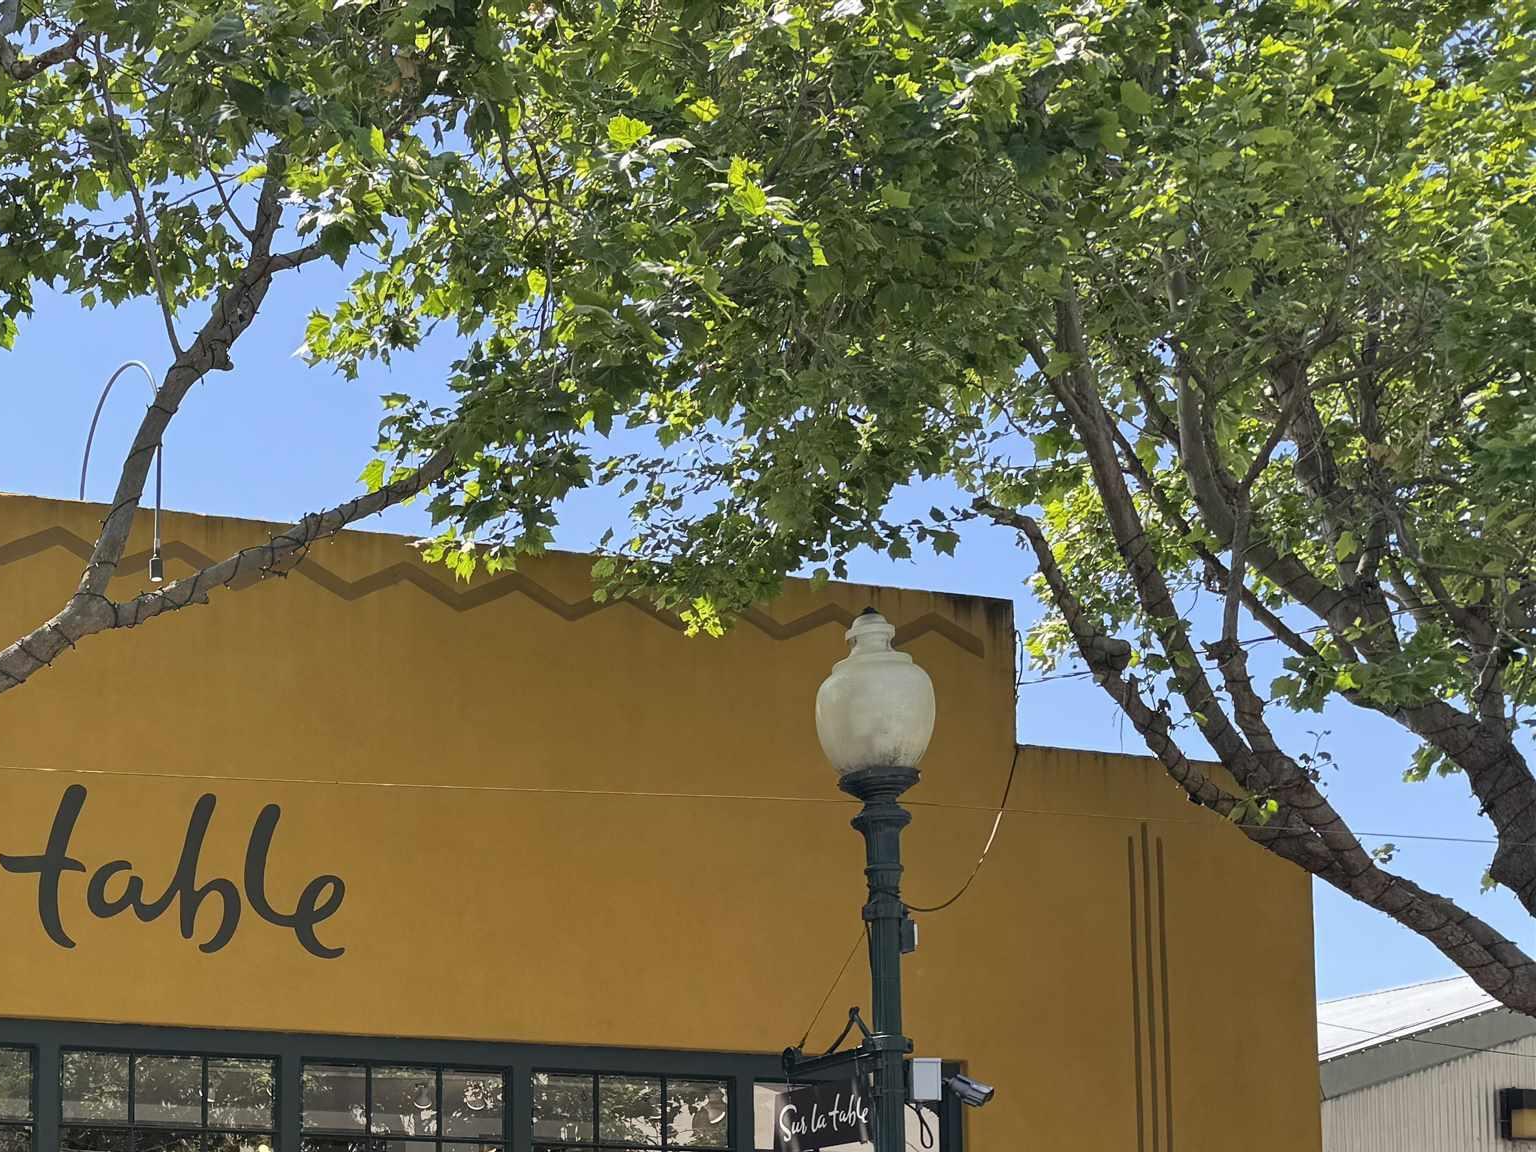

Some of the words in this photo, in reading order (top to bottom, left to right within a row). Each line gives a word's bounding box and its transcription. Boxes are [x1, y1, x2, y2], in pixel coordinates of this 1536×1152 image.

[779, 1104, 808, 1142] Sur
[811, 1103, 828, 1133] la
[828, 1093, 869, 1131] table
